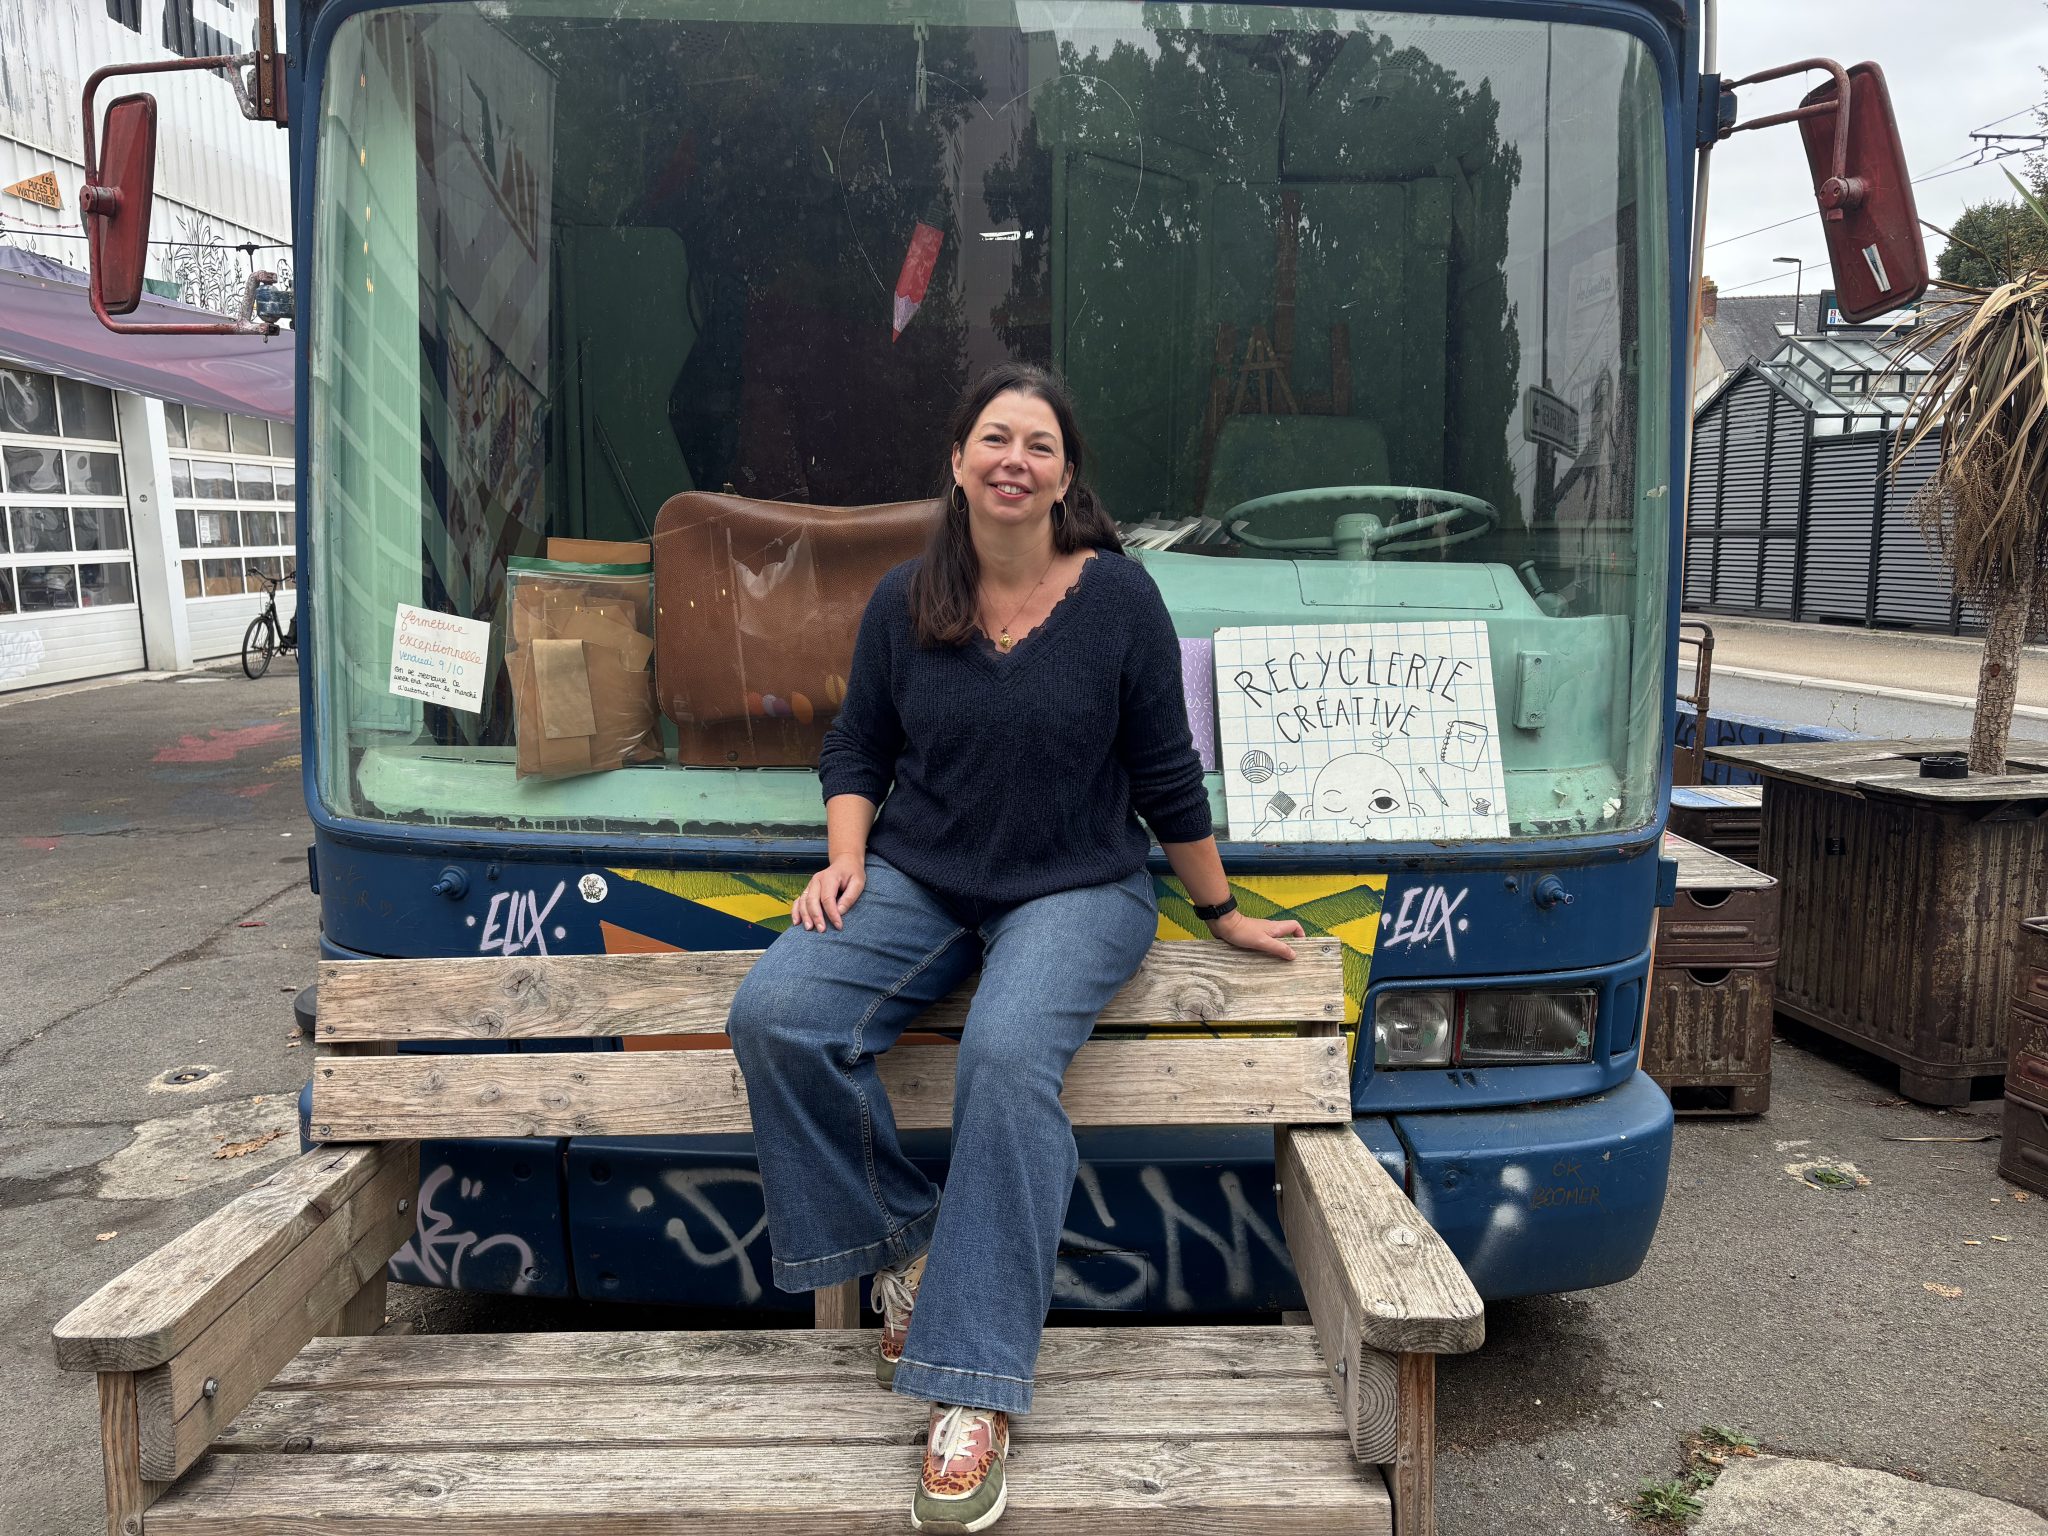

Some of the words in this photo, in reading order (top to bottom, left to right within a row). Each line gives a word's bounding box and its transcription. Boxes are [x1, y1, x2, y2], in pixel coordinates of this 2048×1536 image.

[28, 180, 47, 194] PUCES
[42, 176, 53, 186] LES
[401, 611, 469, 635] fermeture
[399, 633, 483, 665] exceptionnelle
[1233, 647, 1473, 708] RECYCLERIE
[1276, 695, 1421, 744] CRÉATIVE
